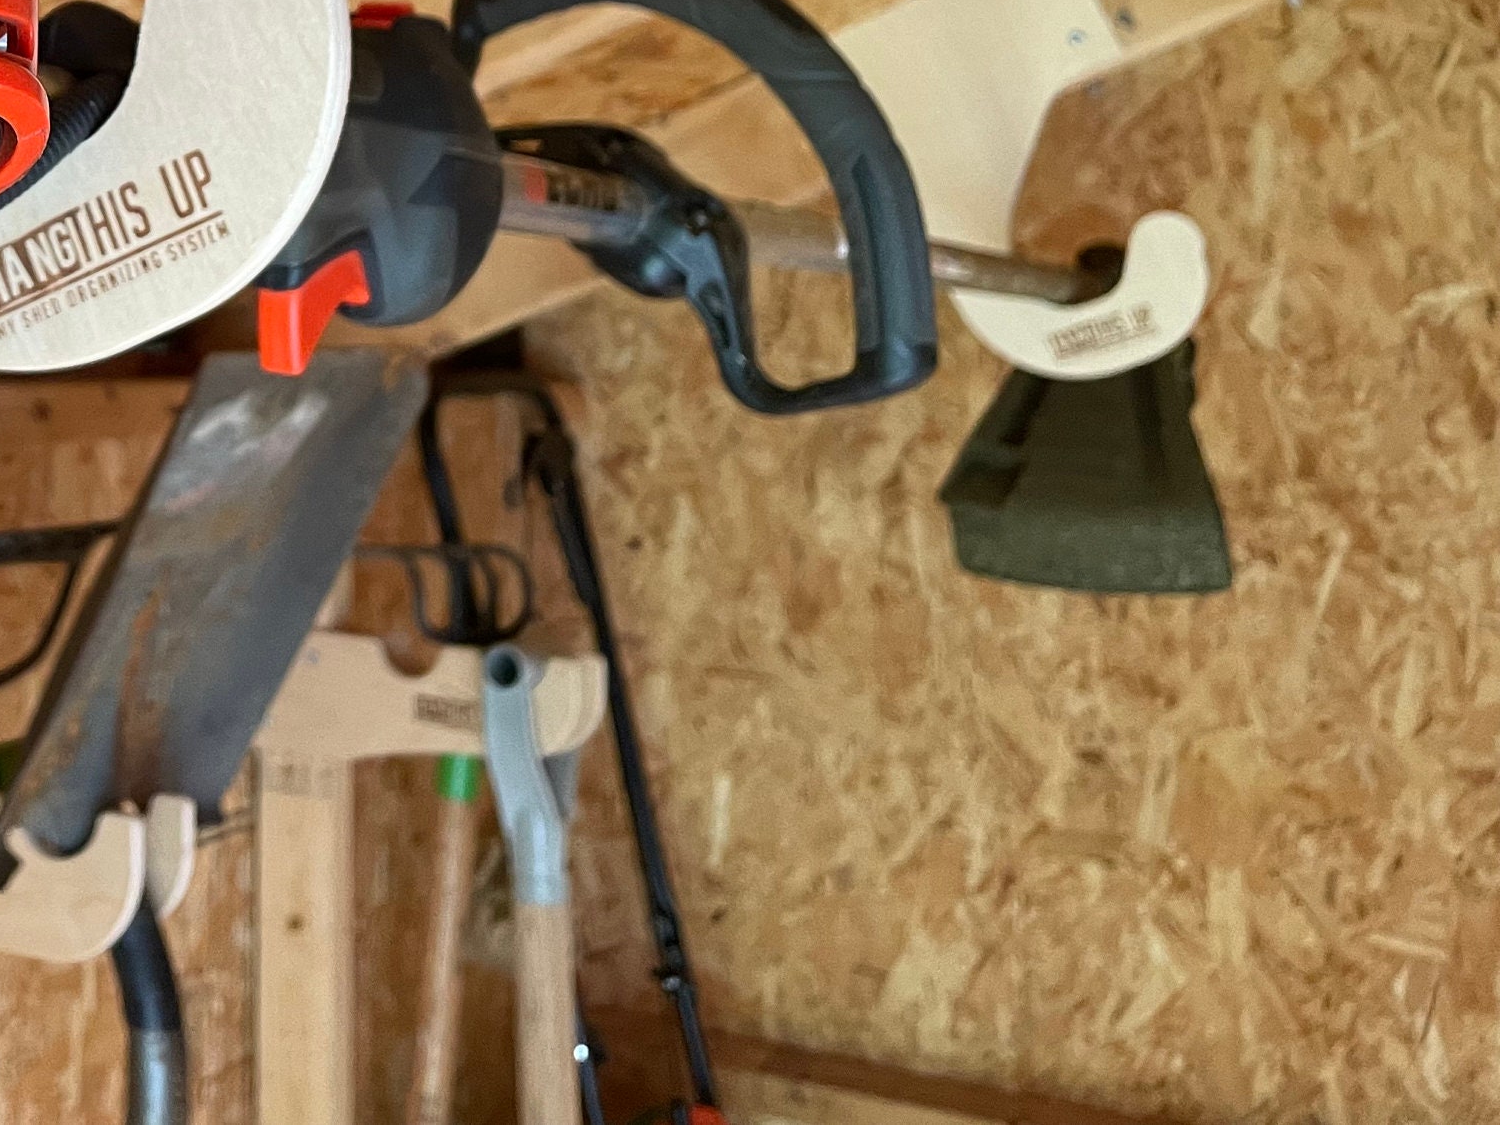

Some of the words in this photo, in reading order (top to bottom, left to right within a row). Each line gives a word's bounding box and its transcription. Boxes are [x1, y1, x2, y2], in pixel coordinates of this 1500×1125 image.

[159, 148, 212, 219] UP
[21, 297, 62, 329] SHED
[66, 250, 163, 309] ORGANIZING
[168, 218, 231, 265] SYSTEM
